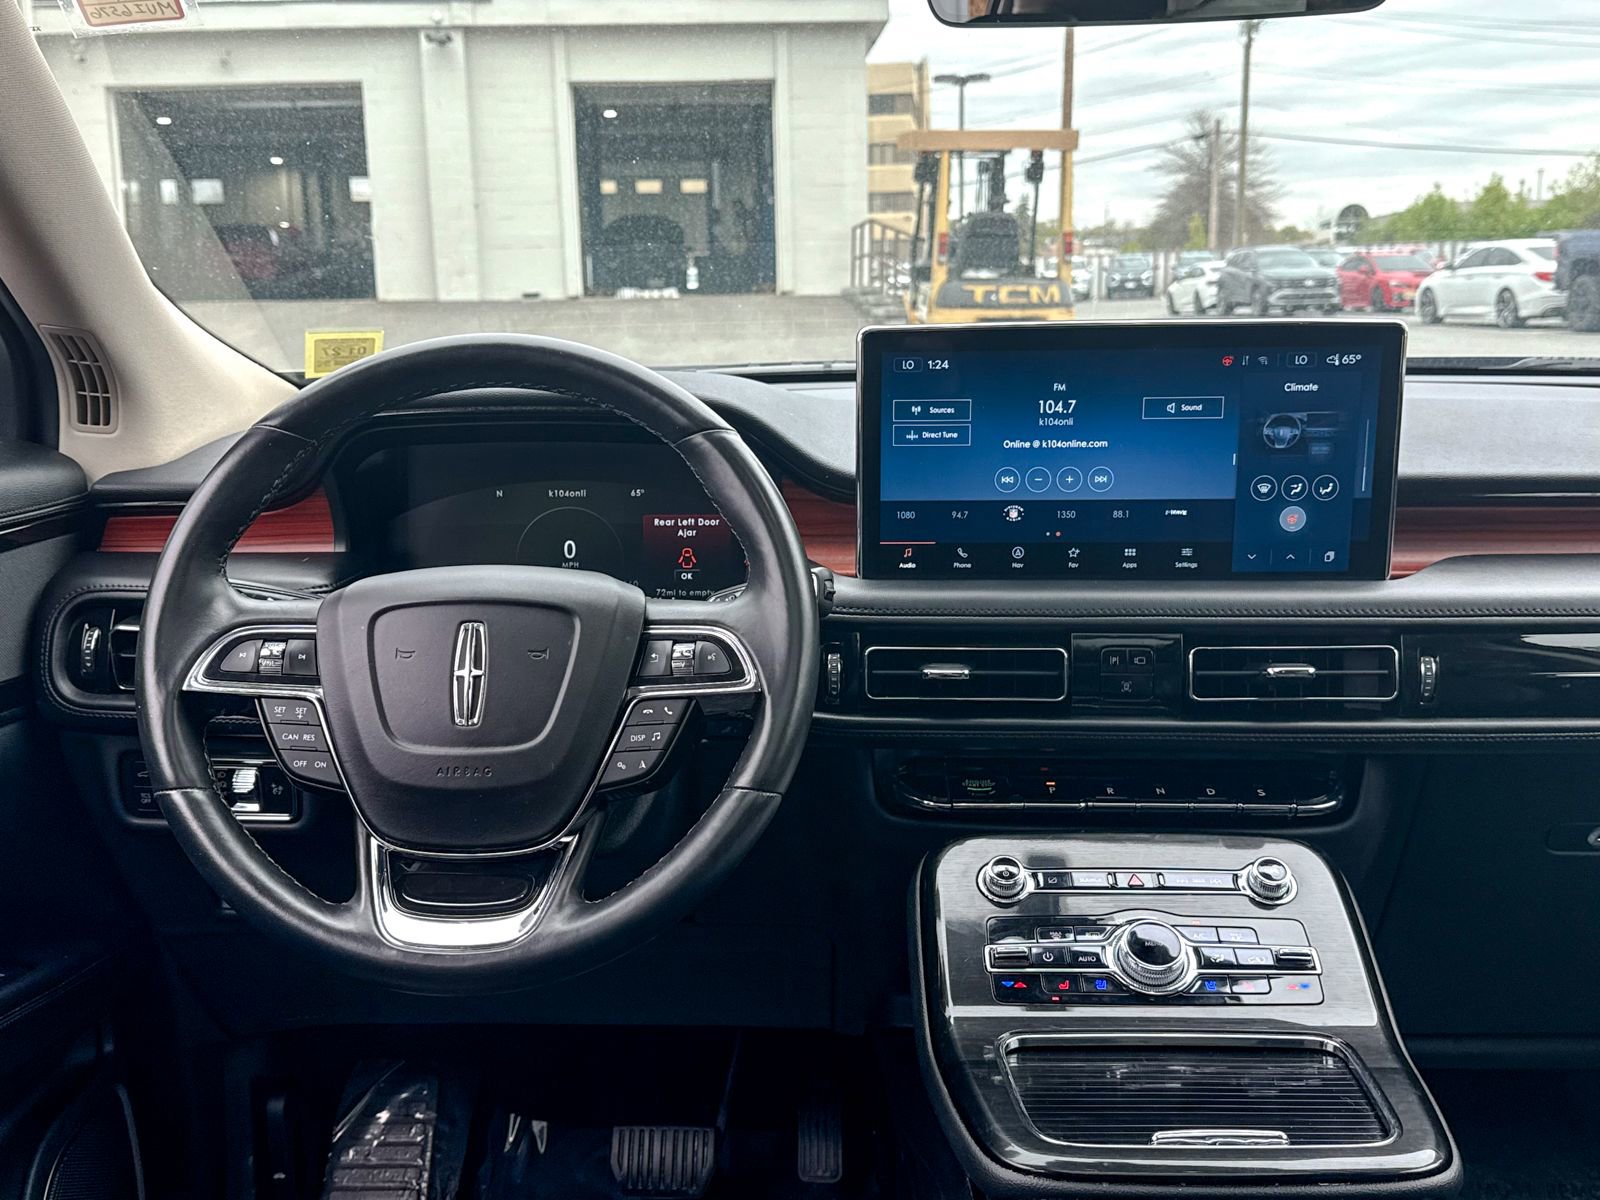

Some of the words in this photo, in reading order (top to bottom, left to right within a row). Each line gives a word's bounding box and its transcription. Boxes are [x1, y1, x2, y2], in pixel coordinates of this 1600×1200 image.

[962, 284, 1061, 304] TCM
[1295, 356, 1308, 365] LO
[1342, 354, 1362, 365] 65°
[902, 360, 914, 370] LO
[928, 360, 949, 370] 1:24
[1053, 383, 1066, 392] FM
[1284, 383, 1318, 392] Climate
[929, 406, 955, 414] Sources
[1038, 400, 1076, 414] 104.7
[1180, 403, 1202, 412] Sound
[1039, 417, 1074, 427] k104onli
[922, 431, 940, 440] Direct
[942, 431, 958, 440] Tune
[1003, 439, 1031, 449] Online
[1032, 440, 1040, 450] @
[1042, 439, 1108, 450] k104online.com
[496, 490, 503, 498] N
[548, 489, 587, 498] k104onli
[896, 510, 916, 520] 1080
[951, 510, 969, 520] 94.7
[1056, 510, 1076, 520] 1350
[1112, 510, 1130, 520] 88.1
[654, 518, 676, 526] Rear
[678, 518, 695, 526] Left
[698, 518, 720, 526] Door
[677, 529, 697, 538] Ajar
[563, 540, 576, 559] 0
[898, 562, 916, 570] Audio
[953, 562, 972, 570] Phone
[1012, 562, 1024, 570] Nav
[1068, 562, 1080, 570] Fav
[1122, 562, 1138, 570] Apps
[1175, 561, 1198, 570] Settings
[302, 734, 316, 742] RES
[630, 734, 646, 742] DISP
[436, 766, 493, 777] AIRBAG
[1106, 787, 1115, 795] R
[1155, 787, 1166, 795] N
[1257, 789, 1266, 797] S
